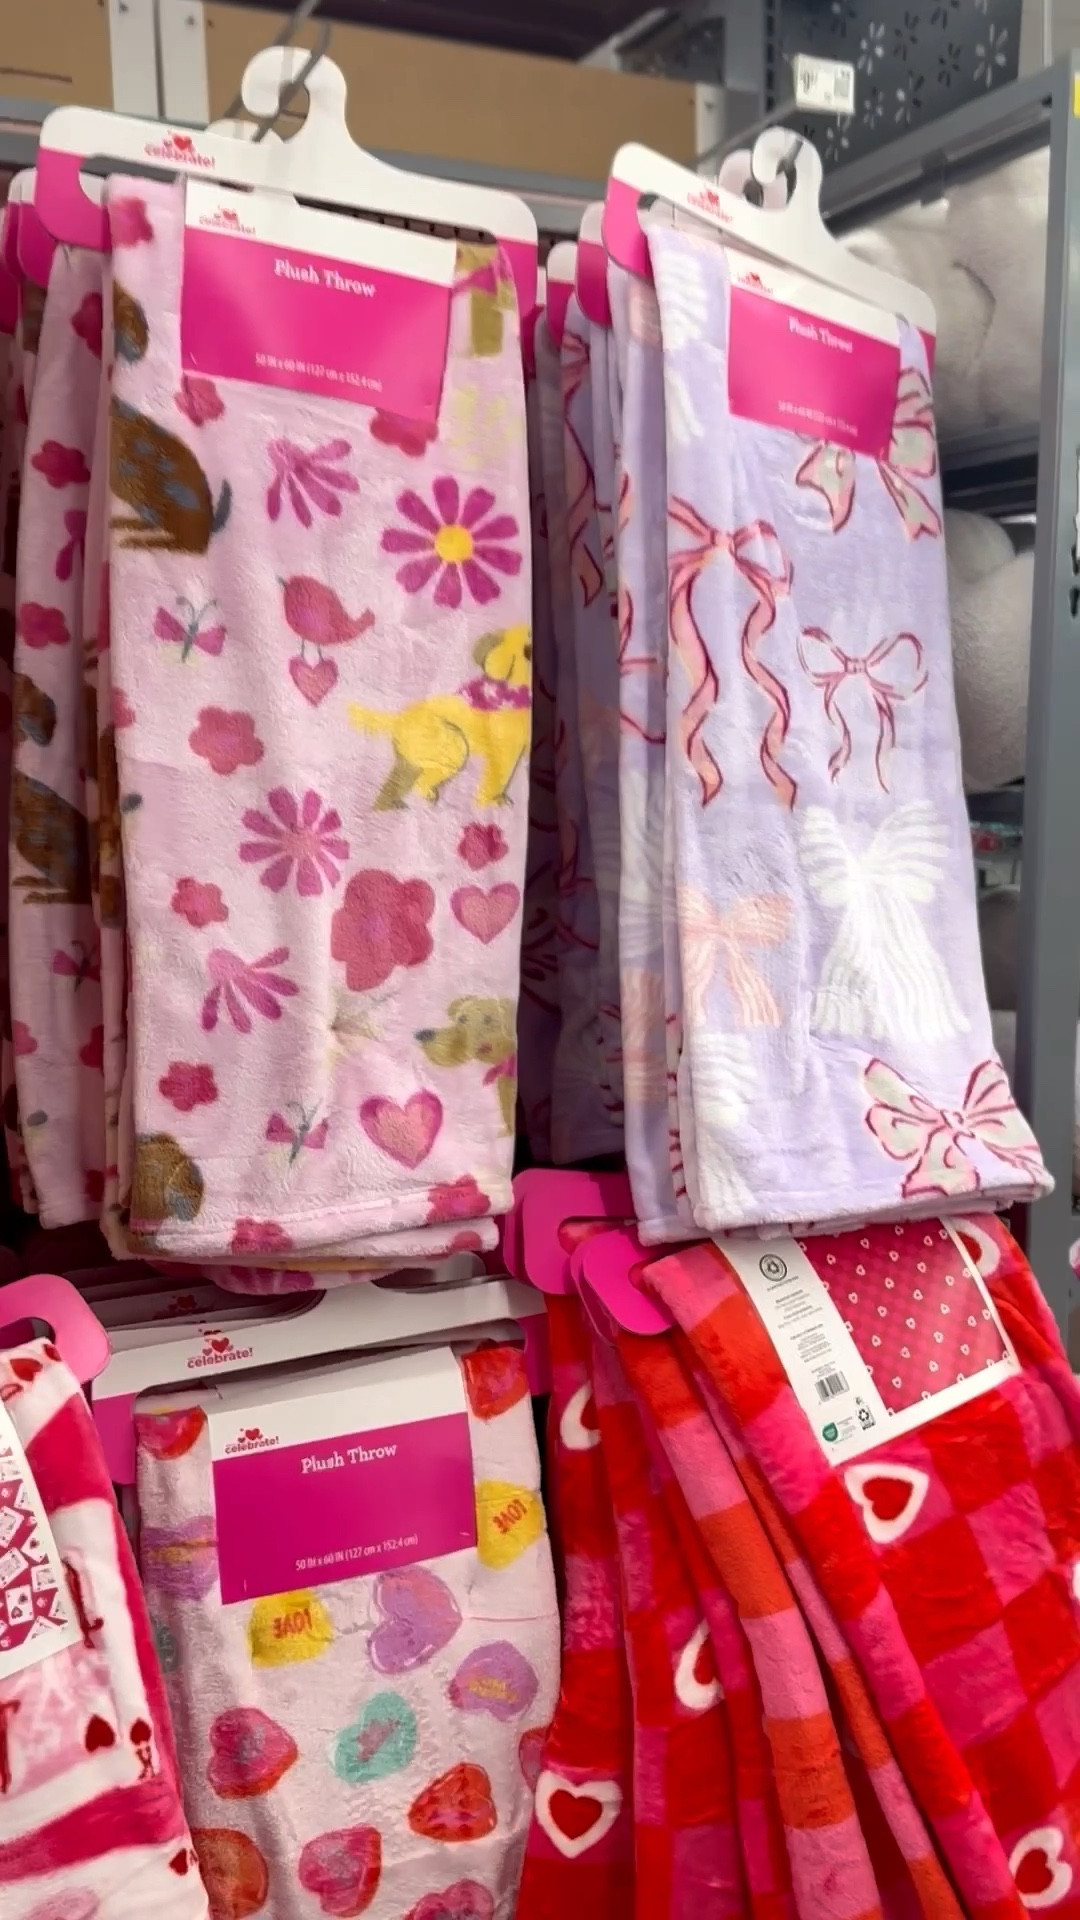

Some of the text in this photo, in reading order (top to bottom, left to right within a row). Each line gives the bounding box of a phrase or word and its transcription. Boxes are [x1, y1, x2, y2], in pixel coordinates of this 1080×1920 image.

[274, 258, 376, 298] Plush Throw
[187, 1347, 253, 1369] celebrate!
[225, 1436, 279, 1454] celebrate!
[301, 1444, 398, 1475] Plush Throw
[295, 1559, 306, 1571] 50
[323, 1553, 334, 1565] 60
[345, 1546, 363, 1562] (127
[363, 1543, 376, 1556] cm
[403, 1533, 419, 1547] cm)
